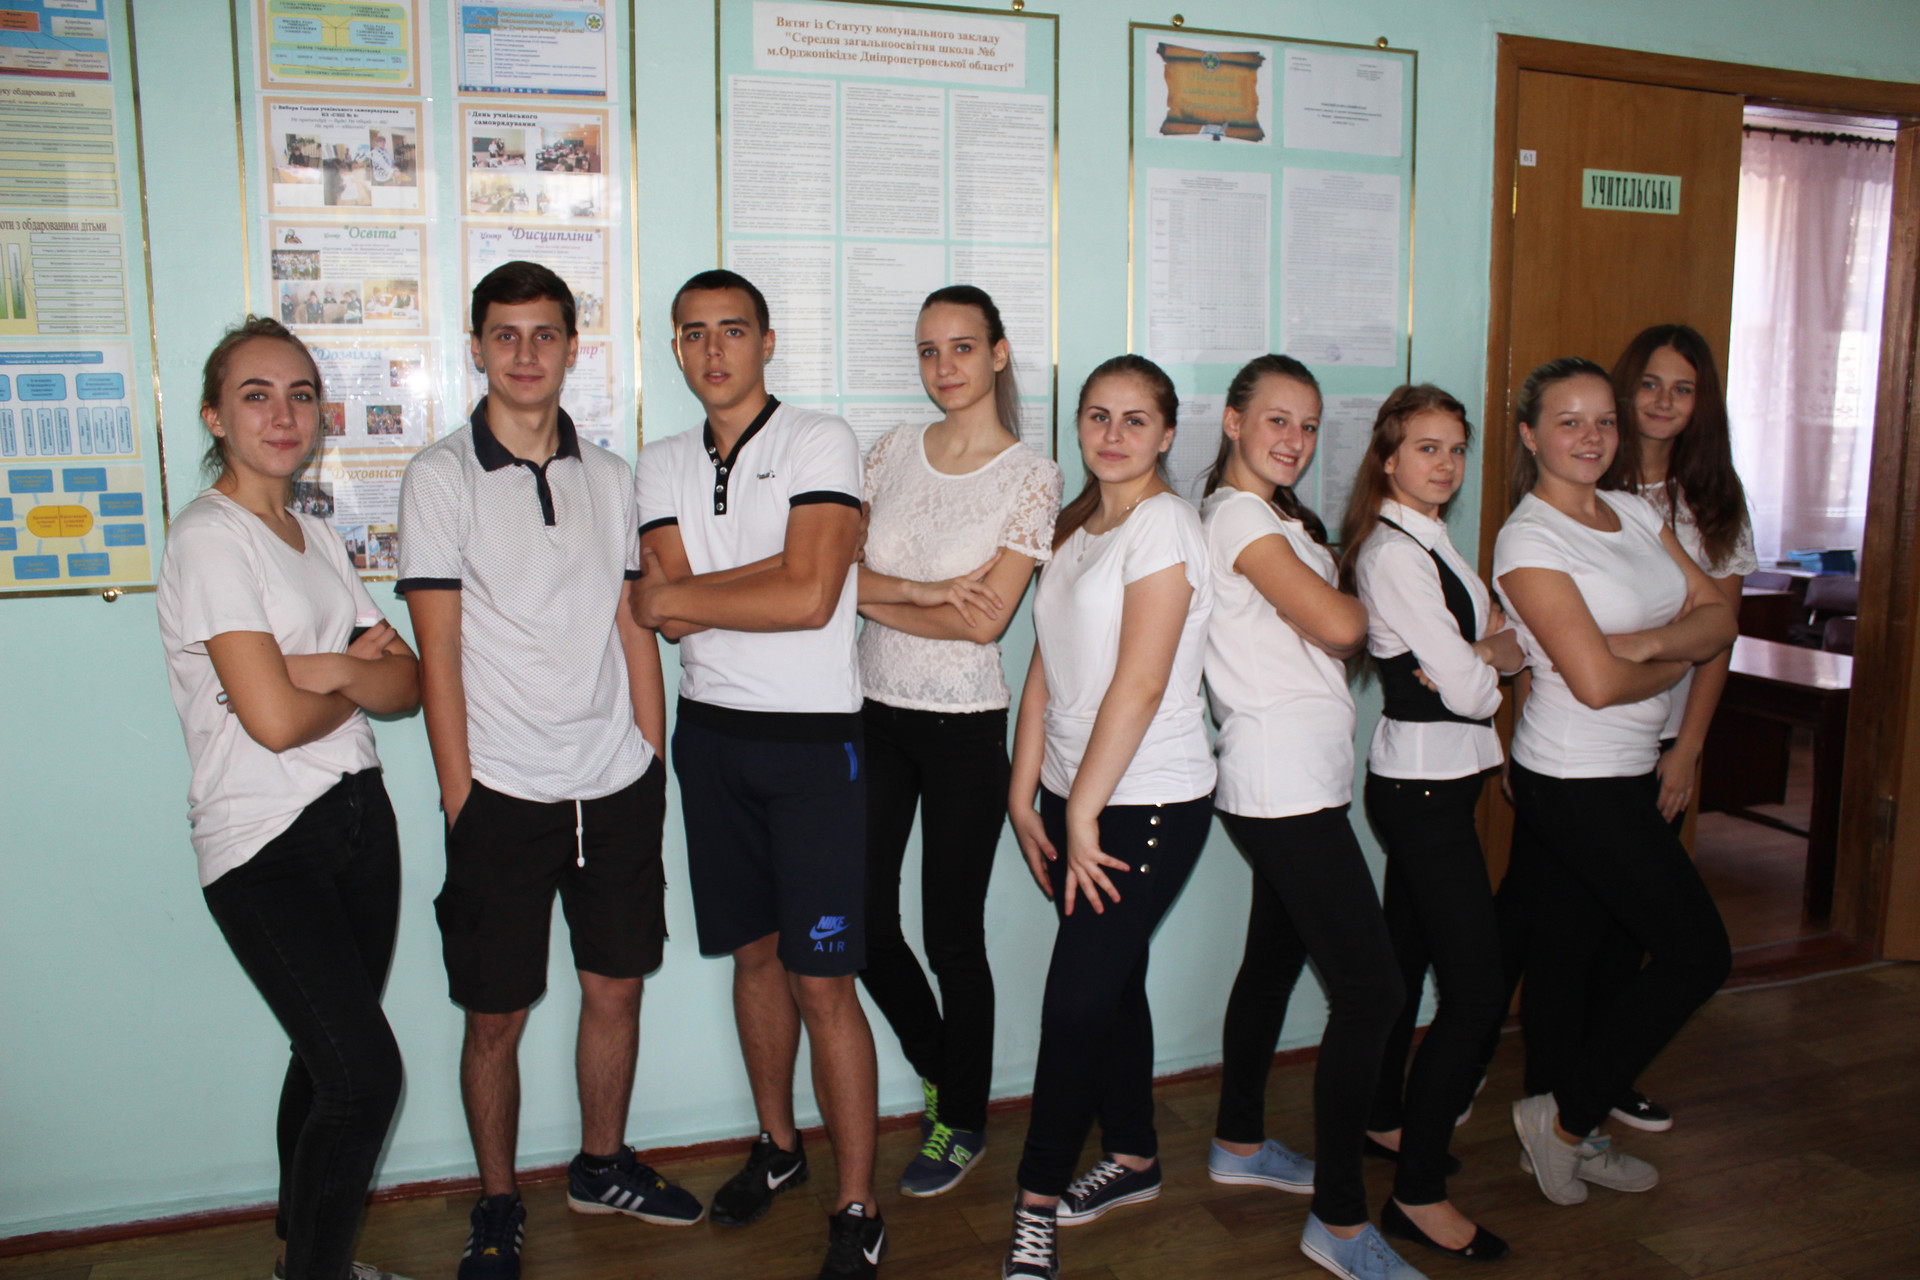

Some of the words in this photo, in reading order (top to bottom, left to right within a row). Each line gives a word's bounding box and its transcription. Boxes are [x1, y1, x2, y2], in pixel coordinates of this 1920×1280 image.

[776, 16, 811, 28] Витяг
[814, 19, 823, 29] із
[826, 19, 872, 34] Статуту
[875, 25, 955, 40] комунального
[957, 32, 1000, 45] закладу
[785, 31, 840, 46] "Середня
[843, 37, 936, 52] загальноосвітня
[938, 45, 975, 56] школа
[977, 46, 996, 57] №6
[767, 46, 857, 61] м.Орджонікідзе
[860, 51, 967, 68] Дніпропетровської
[968, 60, 1014, 73] області"
[1523, 153, 1533, 163] 61
[1591, 174, 1673, 211] УЧИТЕЛЬСЬКА
[22, 217, 80, 234] обдарованими
[81, 220, 107, 232] дітьми
[816, 915, 846, 930] NIKE
[813, 940, 846, 953] AIR
